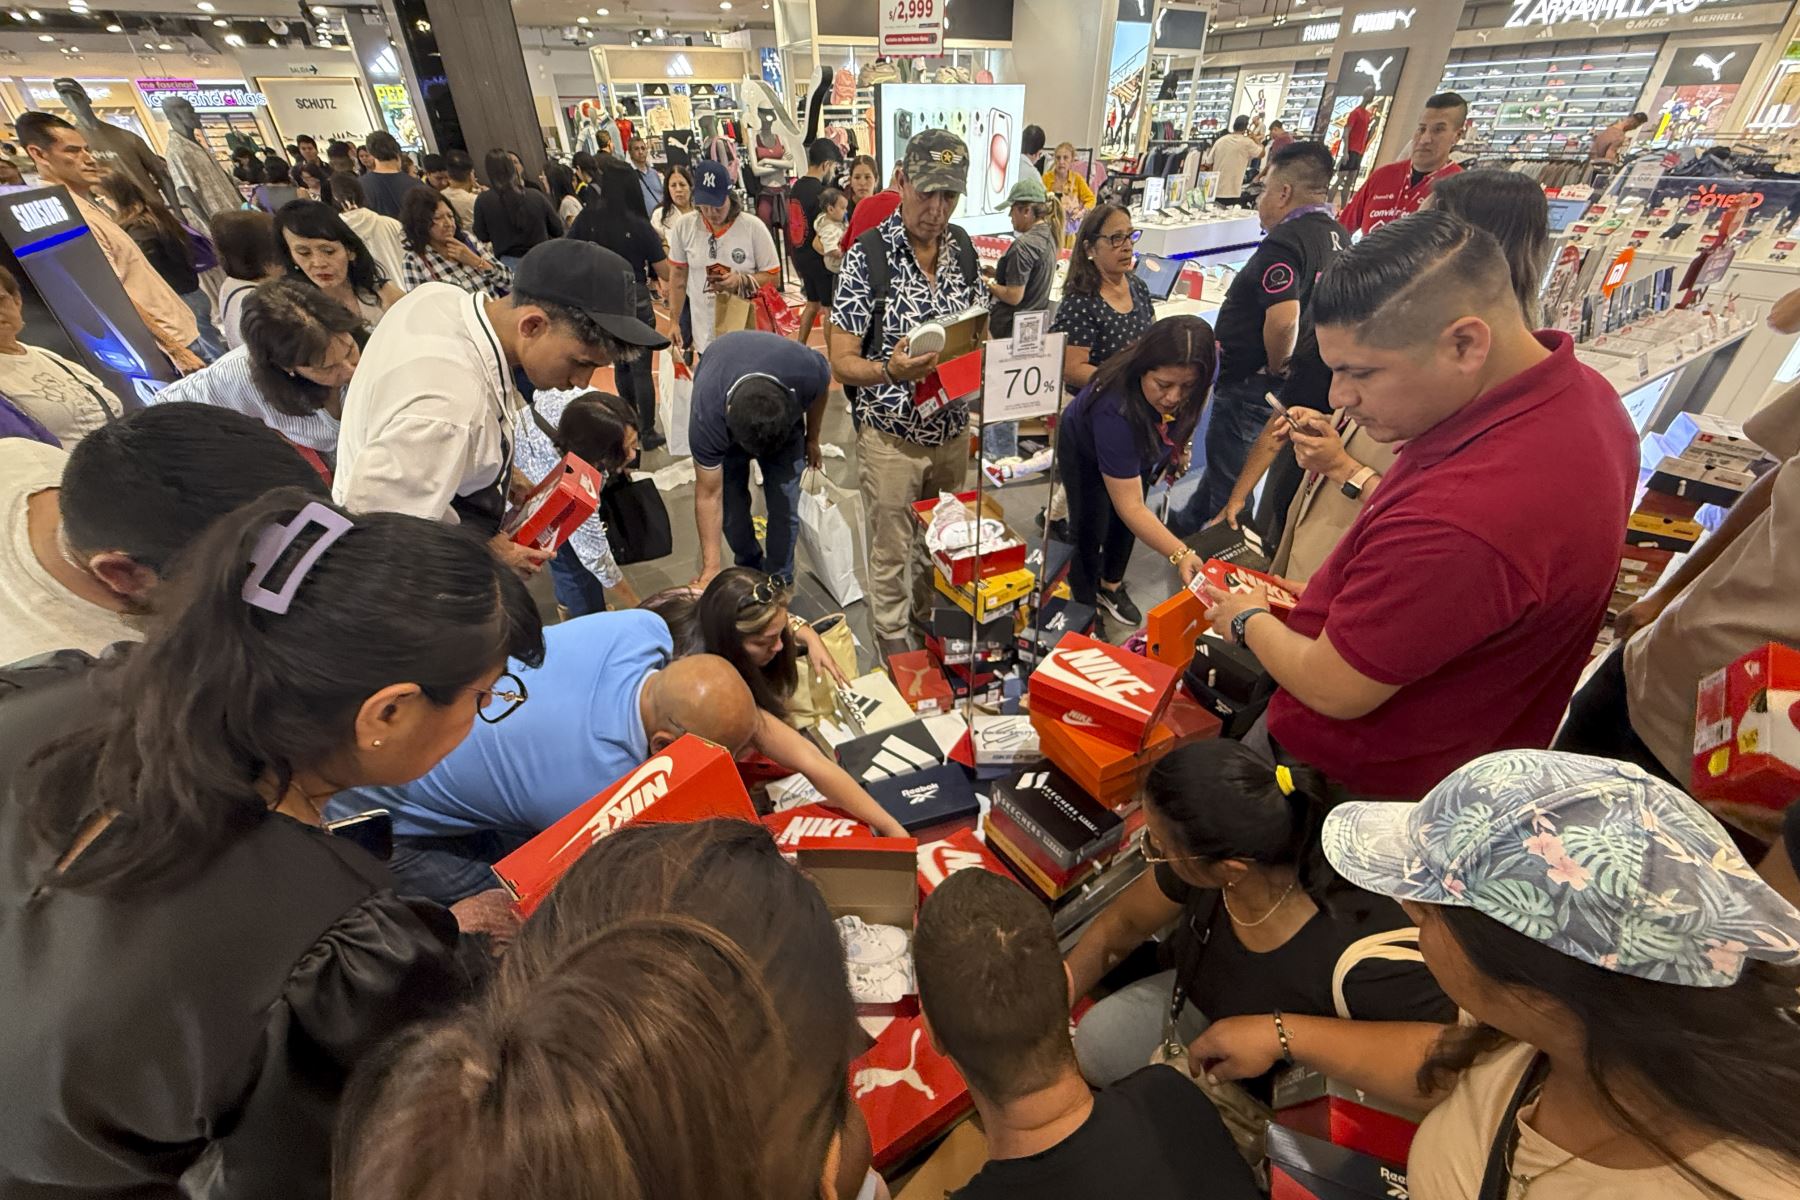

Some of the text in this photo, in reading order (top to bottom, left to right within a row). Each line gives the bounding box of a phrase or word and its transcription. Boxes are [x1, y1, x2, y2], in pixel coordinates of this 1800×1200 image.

[1633, 18, 1670, 29] HI-TEC
[1692, 12, 1745, 24] MERRELL
[295, 98, 337, 110] SCHUTZ
[10, 196, 69, 232] SAMSUNG
[1059, 648, 1156, 700] NIKE
[901, 782, 939, 797] Reebok
[1042, 784, 1079, 816] SKECHERS
[592, 772, 669, 846] NIKE
[1001, 797, 1041, 838] SKECHERS
[776, 816, 858, 845] NIKE
